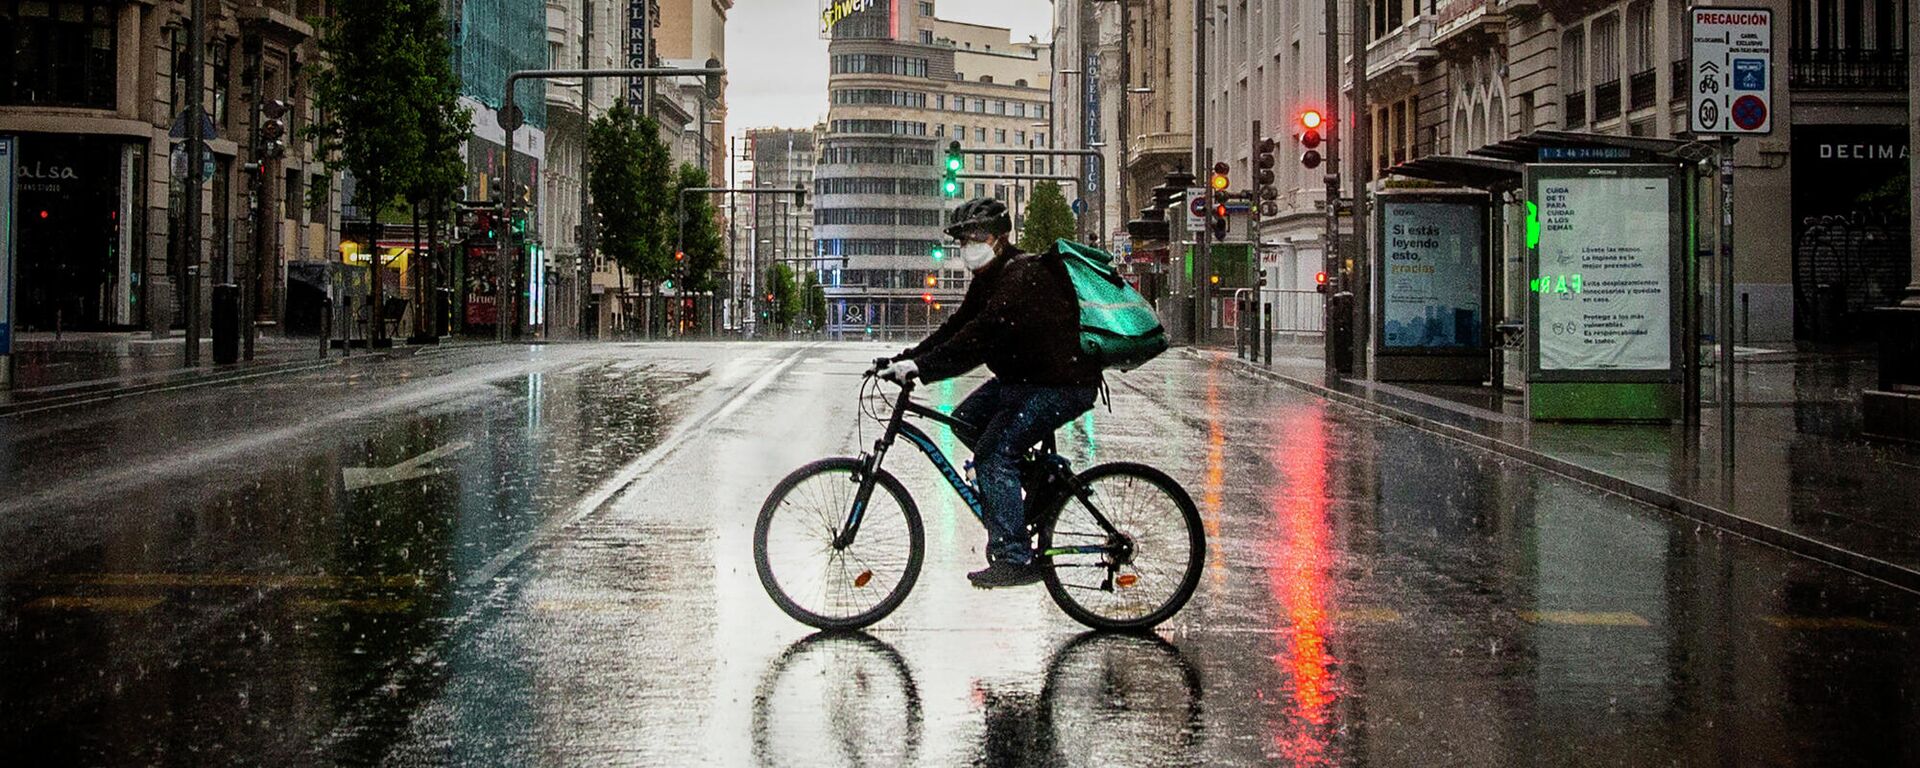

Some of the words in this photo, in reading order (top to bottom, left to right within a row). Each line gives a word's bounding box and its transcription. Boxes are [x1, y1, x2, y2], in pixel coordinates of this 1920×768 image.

[1696, 12, 1767, 26] PRECAUCIÓN
[1702, 106, 1714, 122] 30
[1393, 224, 1405, 235] Si
[1392, 238, 1439, 249] leyendo
[1392, 250, 1421, 261] esto,
